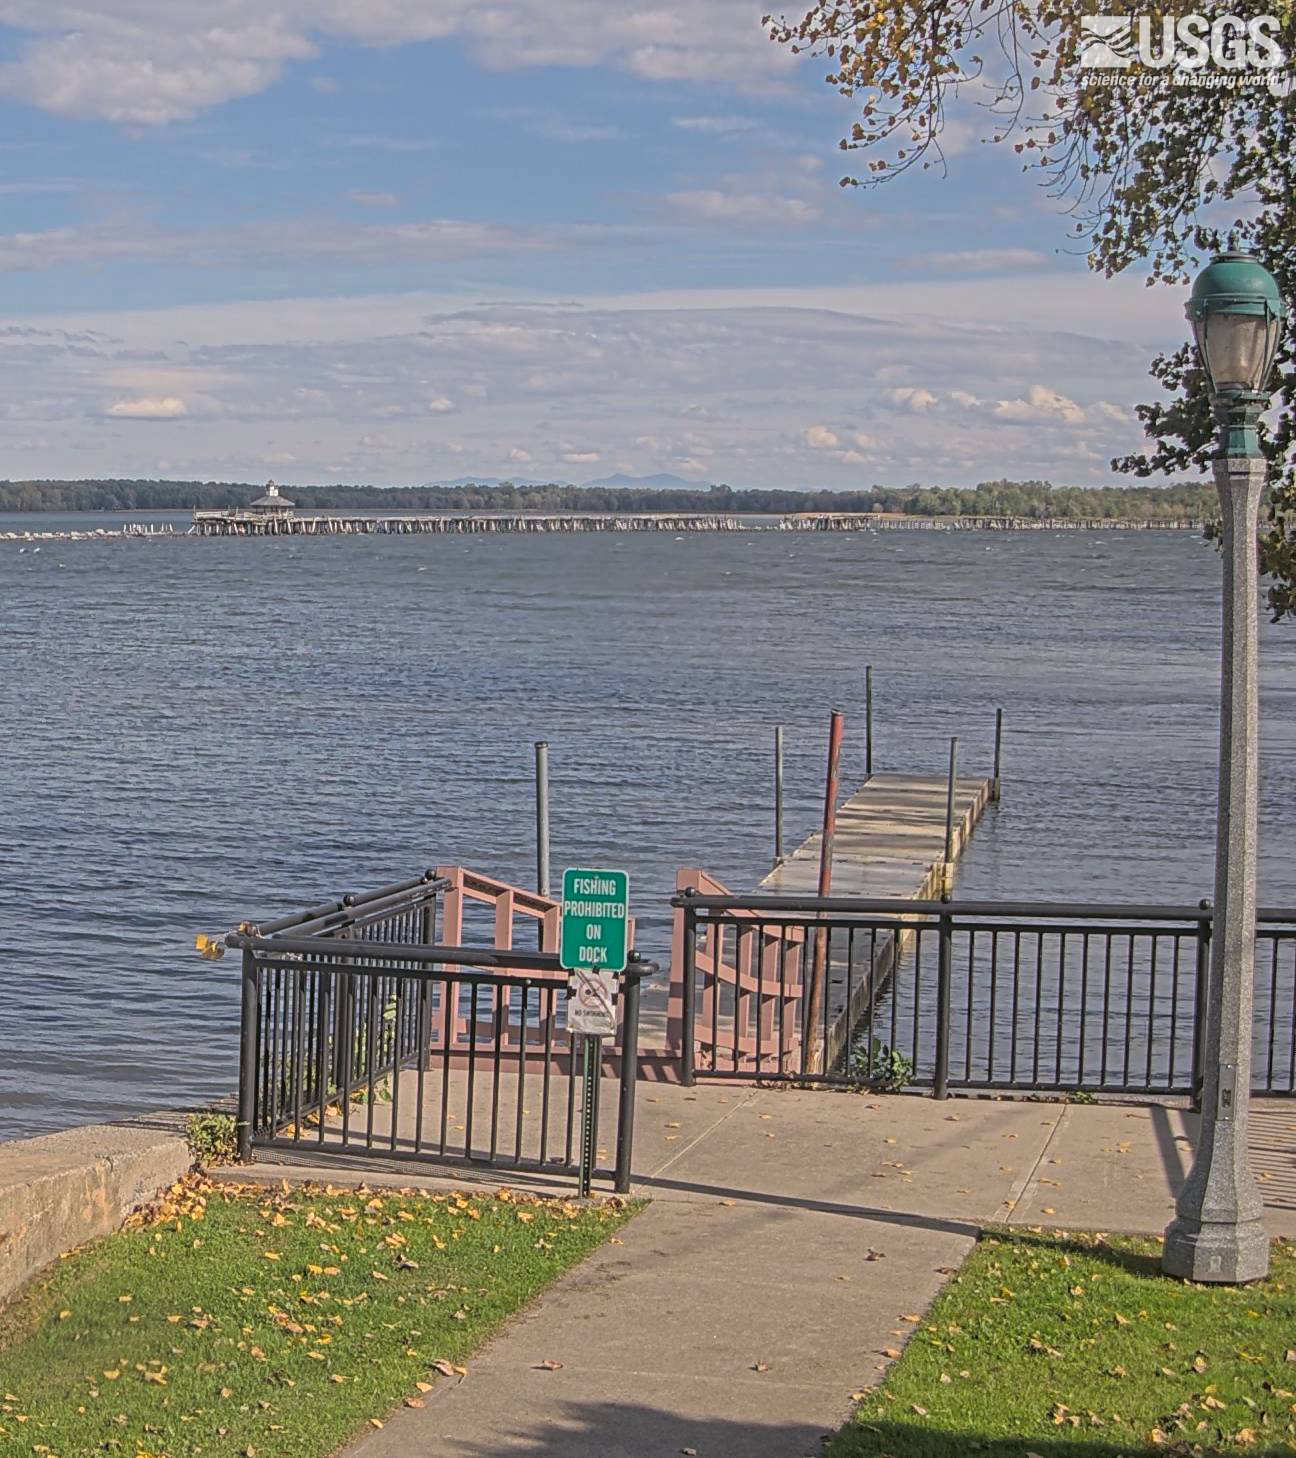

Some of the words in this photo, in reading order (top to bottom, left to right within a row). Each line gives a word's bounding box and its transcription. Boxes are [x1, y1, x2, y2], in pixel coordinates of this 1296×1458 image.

[574, 878, 616, 896] FISHING
[564, 901, 625, 919] PROHIBITED
[585, 924, 602, 940] ON
[579, 946, 608, 963] DOCK
